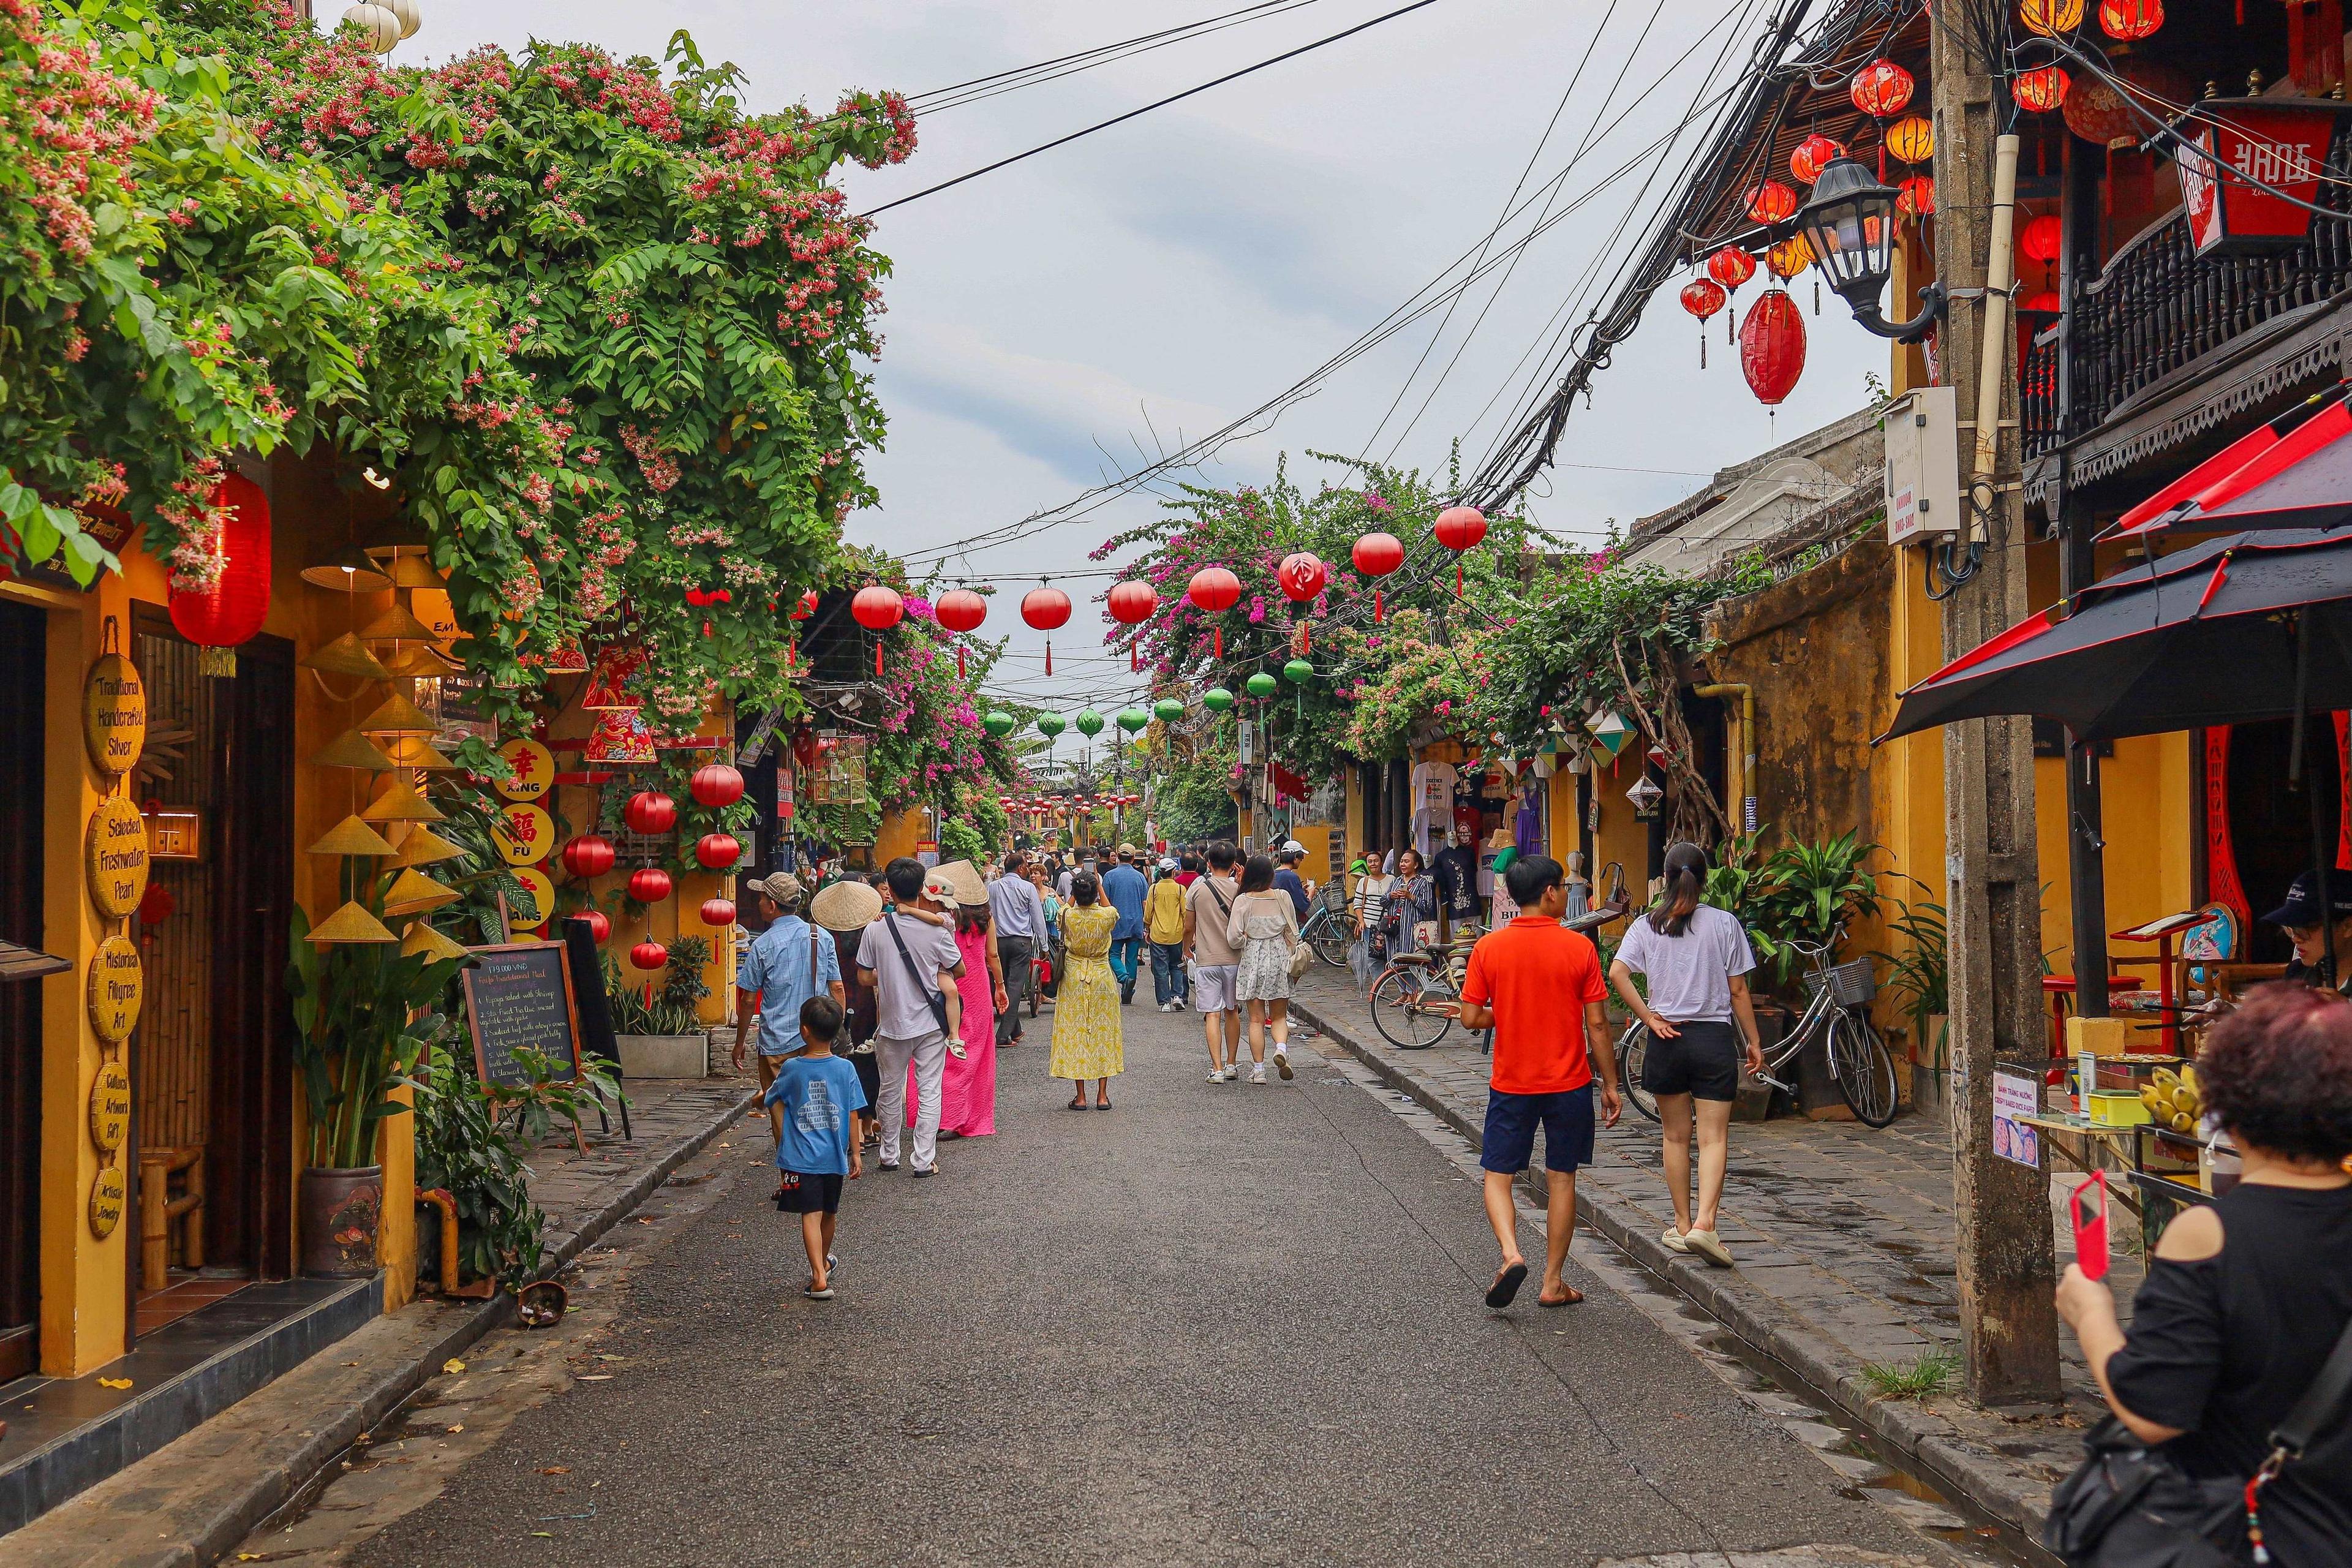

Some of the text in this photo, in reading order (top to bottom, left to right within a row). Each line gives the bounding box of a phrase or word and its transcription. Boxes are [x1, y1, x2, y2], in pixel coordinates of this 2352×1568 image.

[434, 622, 453, 632] EM
[95, 676, 139, 696] Traditional
[108, 736, 132, 756] Silver
[508, 747, 538, 780] 幸
[1746, 797, 1757, 831] 0977333446
[108, 817, 141, 837] Selected
[508, 812, 538, 843] 福
[100, 846, 145, 872] Freshwater
[513, 847, 530, 857] FU
[115, 879, 134, 900] Pearl
[108, 980, 135, 1005] Filigree
[505, 992, 520, 1001] salad
[113, 1011, 126, 1029] Art
[105, 1098, 128, 1115] Artwork
